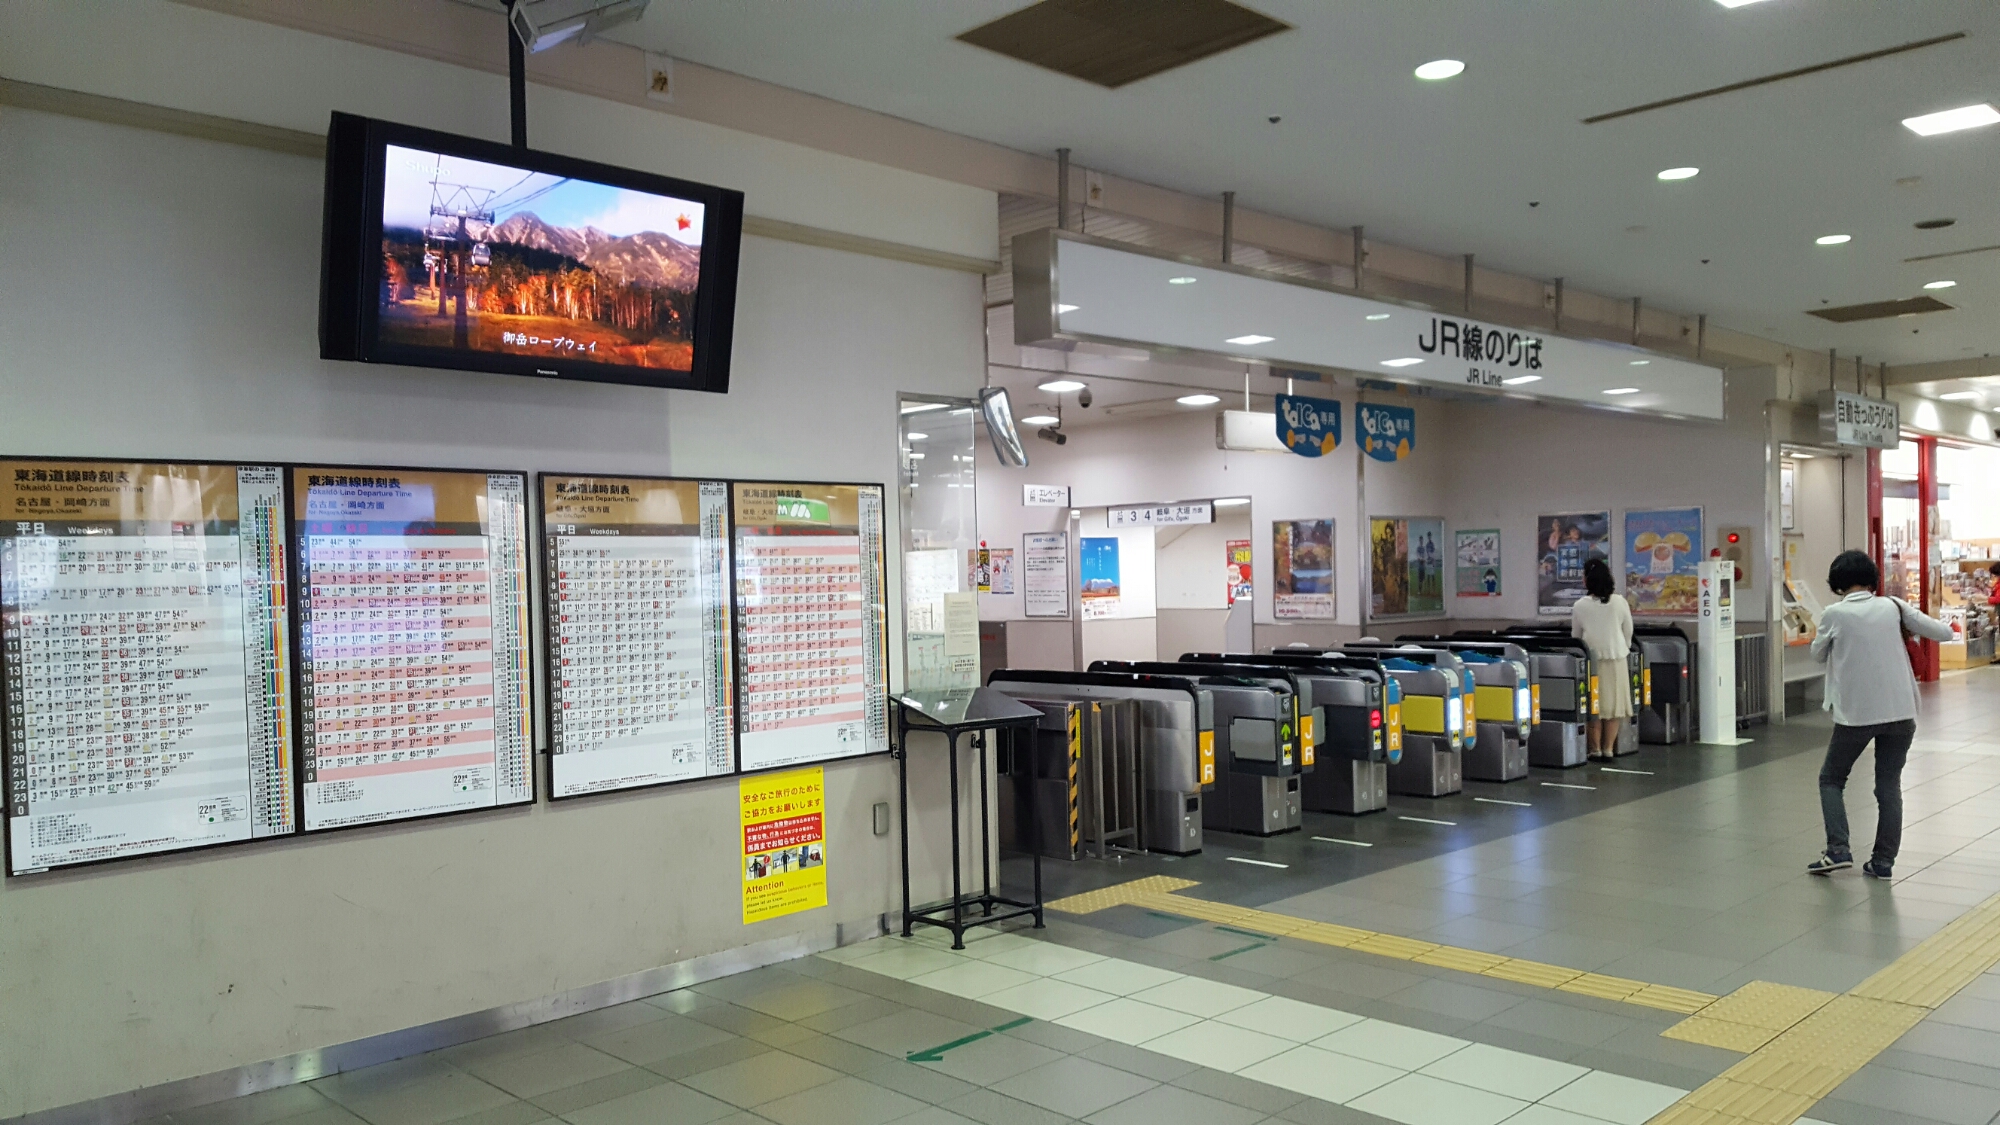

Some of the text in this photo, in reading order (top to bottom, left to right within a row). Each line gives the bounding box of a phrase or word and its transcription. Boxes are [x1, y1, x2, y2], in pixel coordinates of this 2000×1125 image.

[1419, 318, 1543, 370] JR線のりば
[1467, 368, 1504, 387] JR Line
[15, 469, 130, 483] 東海道線時刻表
[308, 475, 401, 488] 東海道線時刻表
[55, 484, 74, 493] Line
[76, 484, 121, 493] Departure
[340, 488, 356, 496] Line
[357, 489, 393, 498] Departure
[395, 490, 413, 498] Time
[1039, 489, 1066, 498] エレベーター
[1130, 510, 1137, 522] 3
[1144, 510, 1151, 521] 4
[16, 522, 114, 536] 平日 Weekdays
[557, 524, 576, 535] 平日
[300, 600, 310, 608] 10
[1703, 590, 1711, 617] AED
[301, 612, 310, 620] 11
[7, 629, 19, 637] 10
[300, 624, 311, 633] 12
[301, 636, 311, 645] 13
[7, 641, 19, 650] 11
[301, 649, 312, 657] 14
[8, 654, 20, 663] 12
[301, 661, 312, 670] 15
[9, 667, 20, 675] 13
[302, 673, 313, 682] 16
[9, 679, 21, 688] 14
[302, 686, 313, 695] 17
[10, 692, 22, 701] 15
[302, 698, 313, 707] 18
[10, 704, 22, 713] 16
[303, 711, 313, 719] 19
[1466, 700, 1474, 733] JR
[11, 718, 23, 726] 17
[303, 723, 314, 732] 20
[1391, 711, 1399, 747] JR
[11, 730, 24, 739] 18
[304, 735, 314, 745] 21
[1304, 724, 1314, 762] JR
[12, 743, 24, 752] 19
[304, 748, 315, 757] 22
[12, 756, 25, 764] 20
[305, 760, 315, 769] 23
[1204, 739, 1214, 781] JR
[13, 768, 25, 777] 21
[14, 780, 26, 790] 22
[14, 793, 27, 802] 23
[744, 785, 821, 804] 安全なご旅行のために
[745, 798, 821, 818] ご協力をお願いします
[746, 881, 784, 894] Attention
